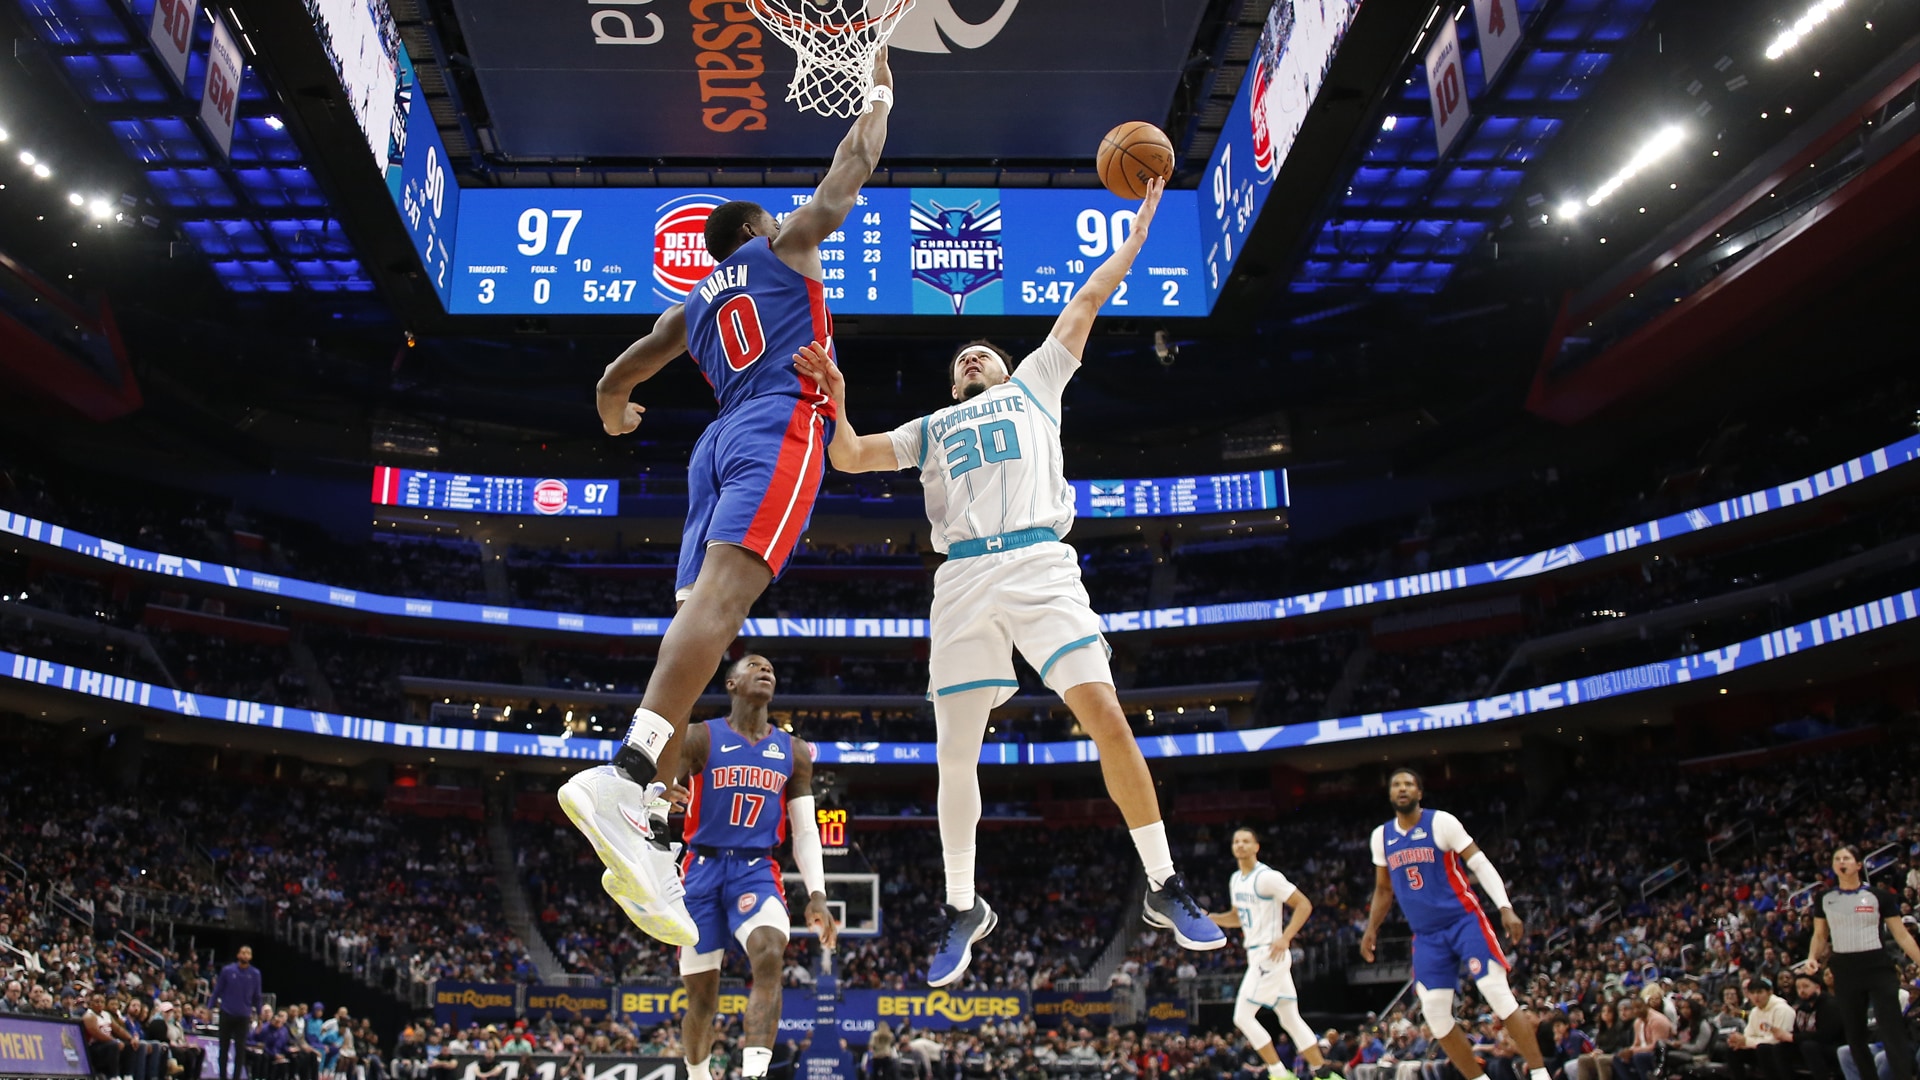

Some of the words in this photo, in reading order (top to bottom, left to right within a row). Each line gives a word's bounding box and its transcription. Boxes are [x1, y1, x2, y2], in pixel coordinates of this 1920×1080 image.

[208, 62, 234, 127] GM
[1436, 62, 1459, 127] 10
[425, 145, 445, 219] 90
[1213, 143, 1231, 220] 97
[792, 195, 813, 206] TEA
[1238, 184, 1254, 233] 5:47
[863, 213, 881, 225] 44
[517, 208, 583, 256] 97
[664, 232, 707, 249] DETR
[863, 231, 881, 244] 32
[1076, 209, 1140, 257] 90
[919, 240, 993, 249] CHARLOTTE
[427, 234, 434, 263] 2
[438, 261, 446, 288] 2
[574, 258, 591, 272] 10
[602, 264, 622, 274] 4th
[663, 250, 717, 267] PISTO
[863, 250, 881, 263] 23
[910, 247, 1003, 270] ORNET
[1036, 265, 1055, 275] 4th
[1066, 260, 1084, 273] 10
[1212, 261, 1219, 290] 3
[1225, 233, 1232, 262] 0
[468, 265, 508, 274] TIMEOUTS:
[531, 265, 558, 274] FOULS:
[824, 269, 845, 279] LKS
[869, 269, 877, 281] 1
[1149, 267, 1189, 276] TIMEOUTS:
[478, 278, 495, 304] 3
[533, 278, 550, 304] 0
[583, 280, 637, 303] 5:47
[700, 265, 748, 304] DUREN
[824, 288, 845, 299] TLS
[868, 288, 878, 300] 8
[1022, 281, 1074, 303] 5:47
[1112, 281, 1128, 305] 2
[1163, 281, 1179, 305] 2
[716, 294, 766, 372] 0
[931, 396, 1024, 443] CHARLOTTE
[943, 419, 1021, 480] 30
[584, 483, 609, 503] 97
[894, 747, 920, 759] BLK
[712, 765, 788, 794] DETROIT
[730, 793, 765, 828] 17
[817, 809, 847, 824] 5:47
[821, 822, 844, 846] 10
[1388, 848, 1435, 870] DETROIT
[1406, 866, 1424, 890] 5
[841, 1019, 876, 1032] CLUB
